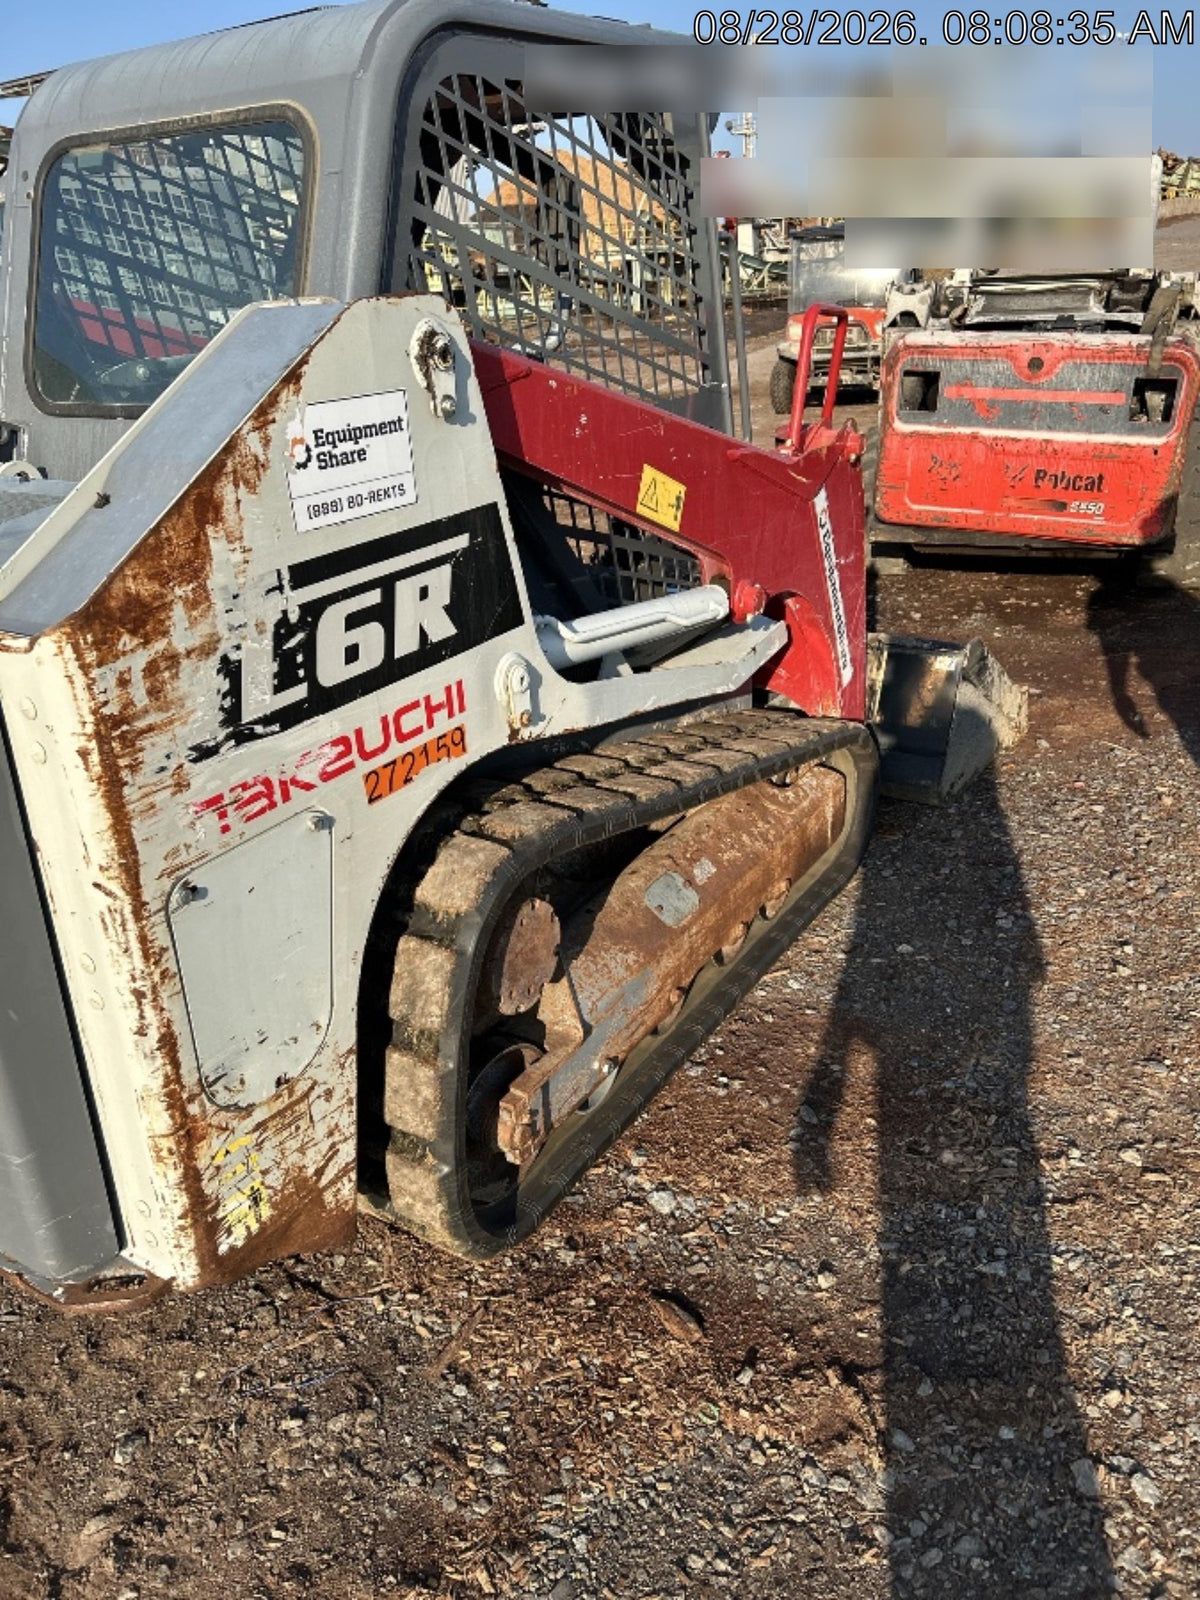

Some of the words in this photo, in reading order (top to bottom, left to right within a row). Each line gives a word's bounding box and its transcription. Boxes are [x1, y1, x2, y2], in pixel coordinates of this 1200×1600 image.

[312, 415, 405, 450] Equipment
[315, 447, 368, 471] Share
[363, 725, 468, 804] 272159
